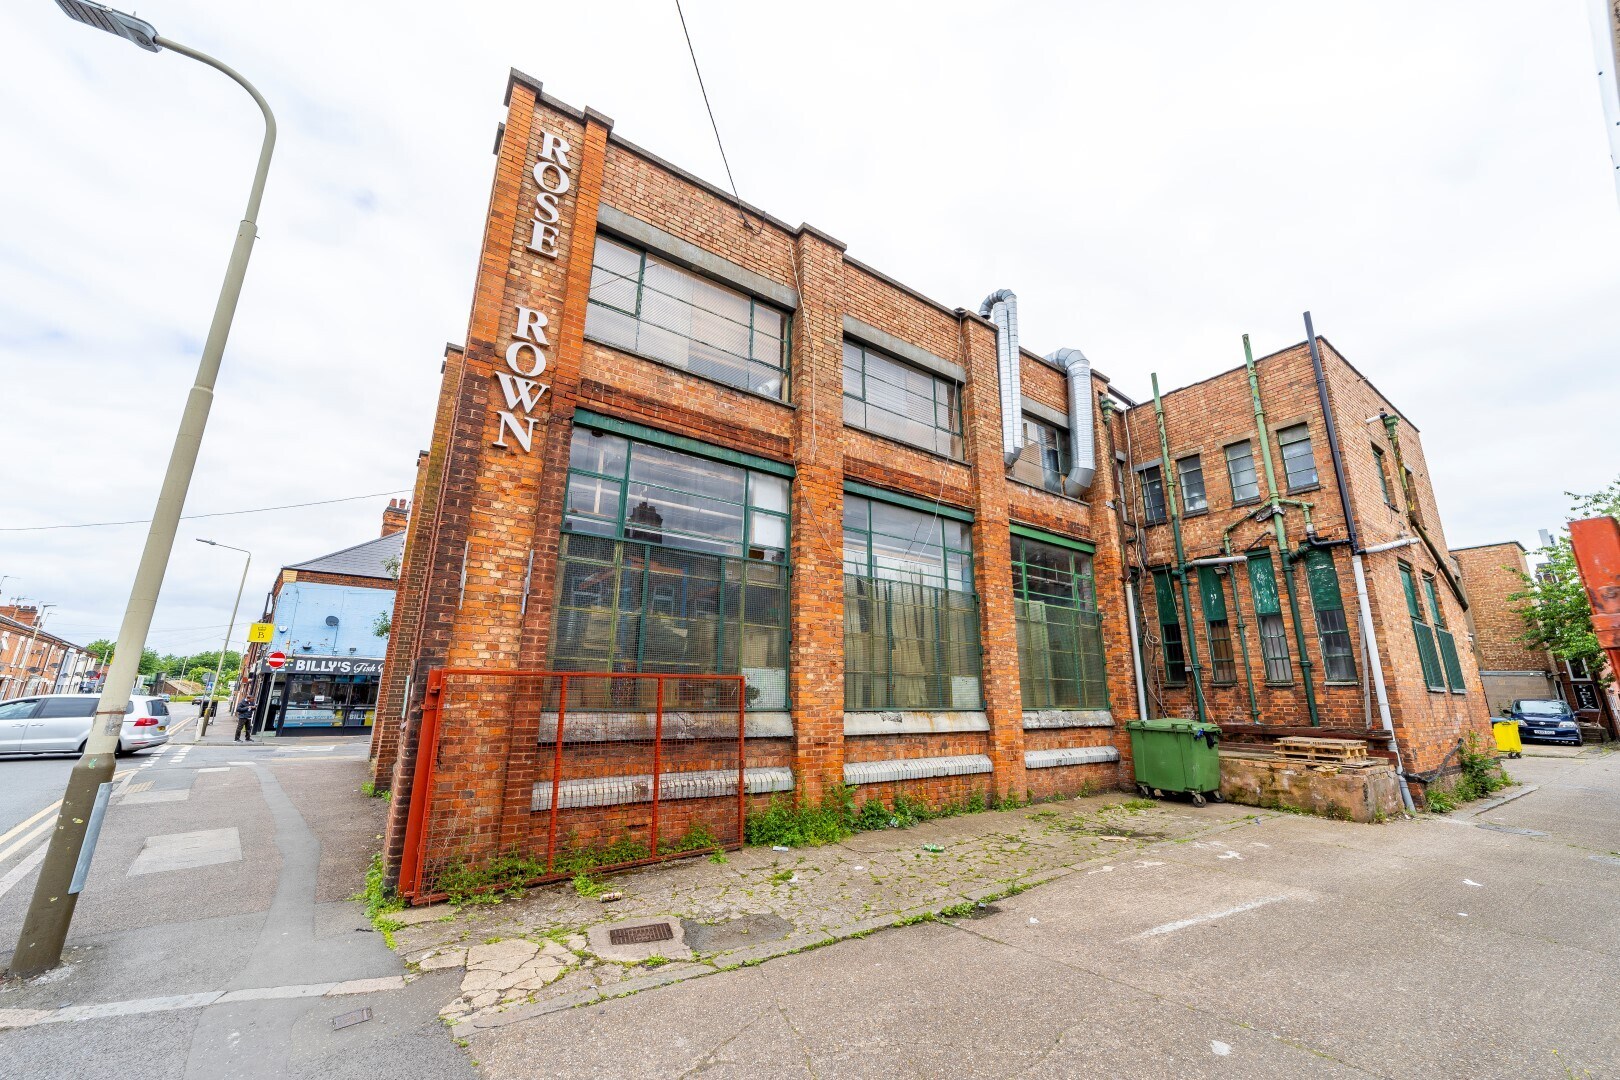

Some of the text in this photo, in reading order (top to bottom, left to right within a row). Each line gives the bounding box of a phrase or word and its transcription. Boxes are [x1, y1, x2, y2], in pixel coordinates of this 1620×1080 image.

[492, 130, 572, 453] ROSE ROWN
[296, 660, 351, 672] BILLY'S
[353, 662, 376, 673] Fish
